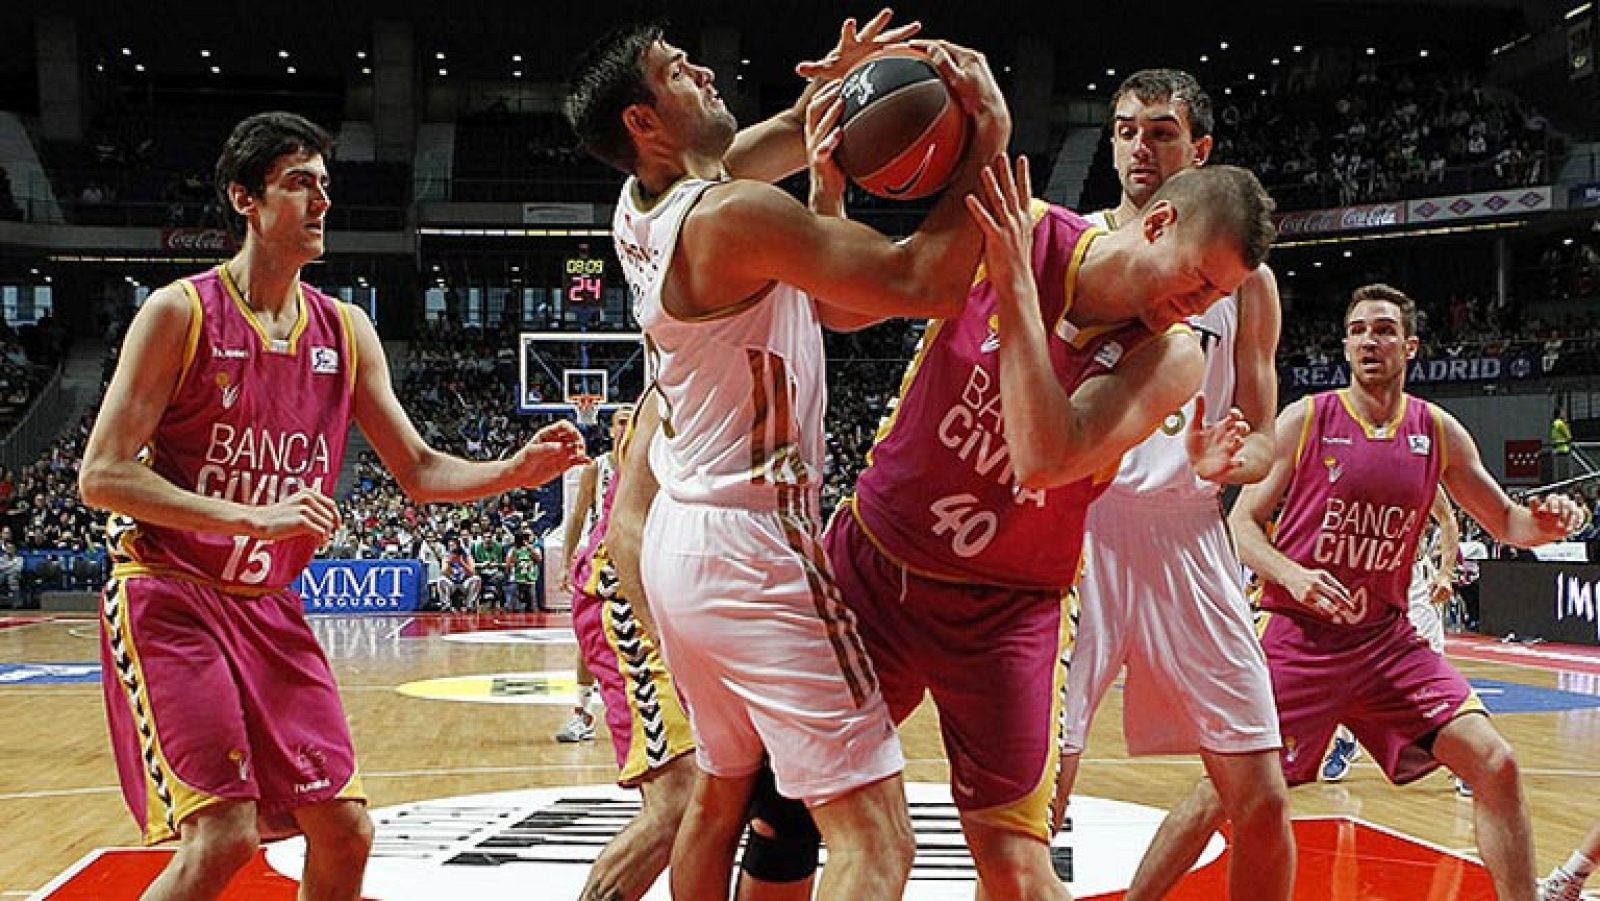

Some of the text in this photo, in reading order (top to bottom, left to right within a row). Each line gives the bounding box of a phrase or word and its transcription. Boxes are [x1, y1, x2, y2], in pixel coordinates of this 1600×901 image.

[570, 277, 601, 301] 24
[1293, 358, 1501, 386] REA ADRID
[205, 422, 330, 474] BANCA
[930, 494, 998, 558] 40
[1322, 497, 1418, 540] BANCA
[220, 534, 274, 584] 15
[299, 566, 414, 599] MMT
[313, 597, 399, 608] SEGUROS
